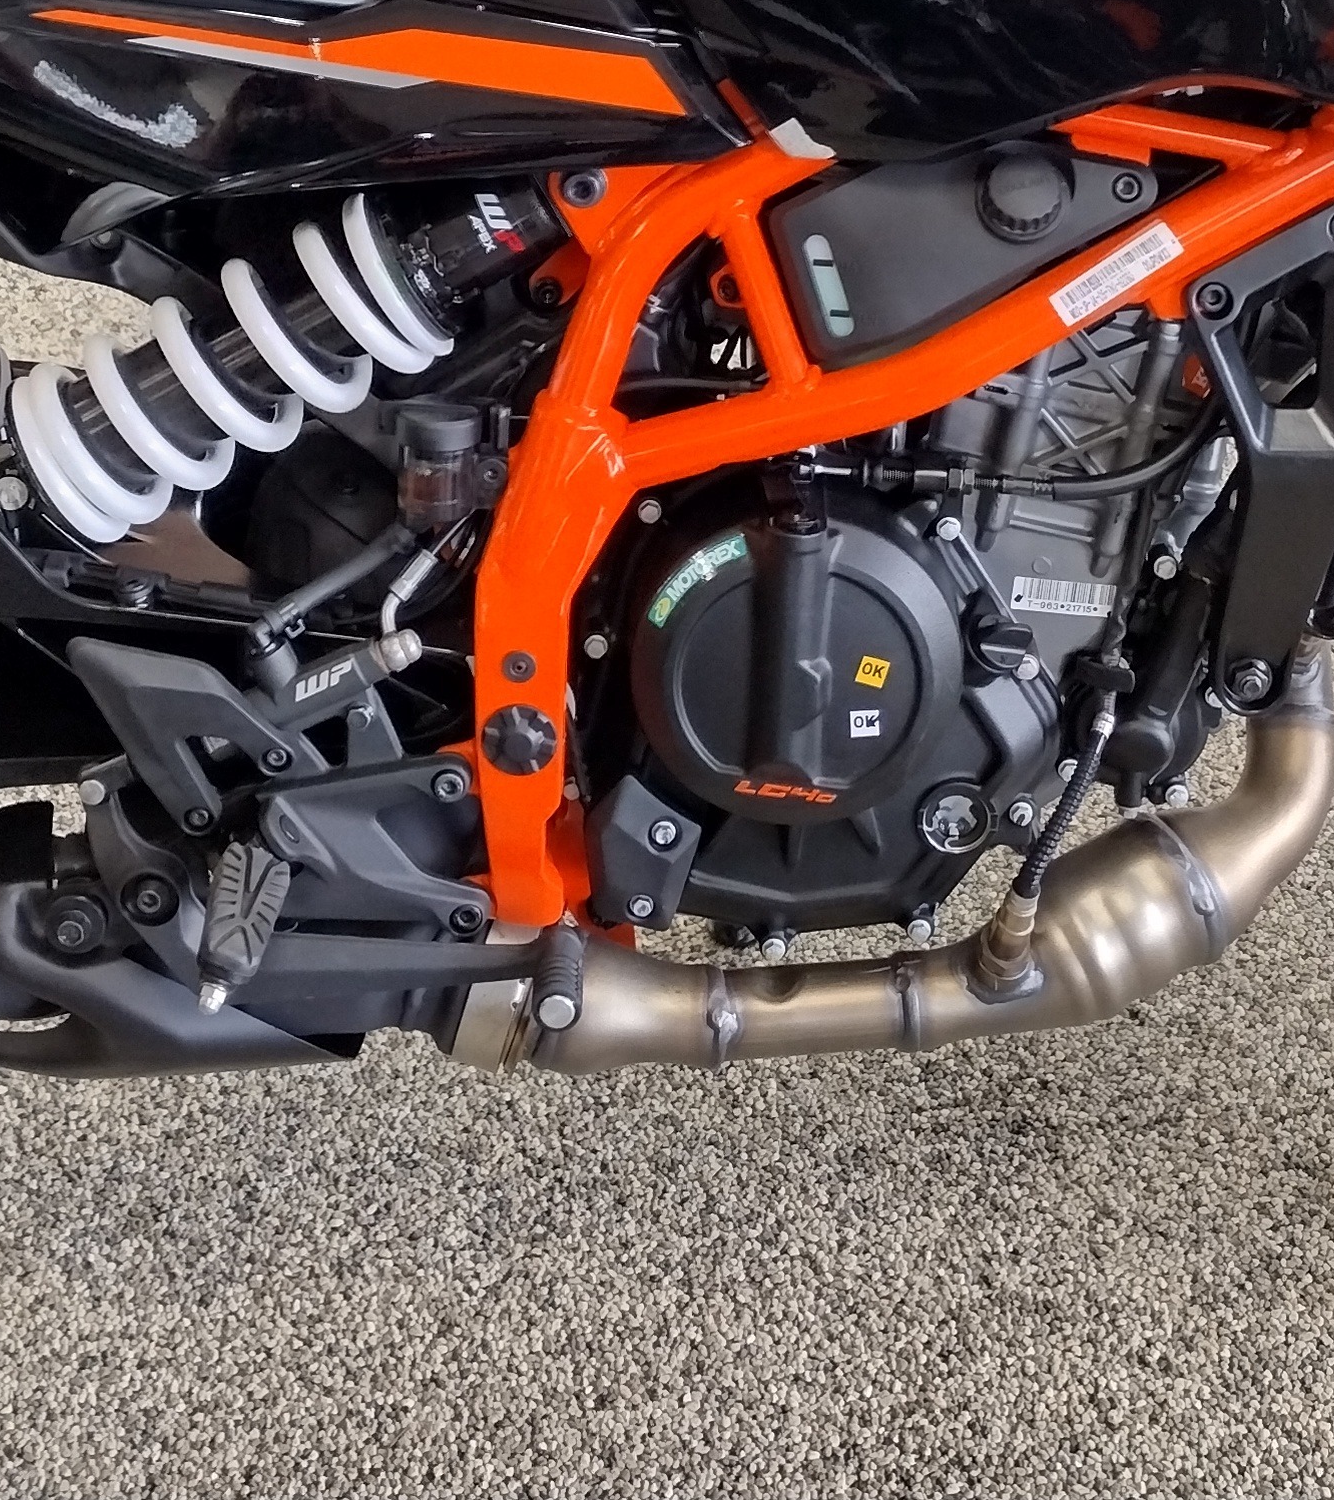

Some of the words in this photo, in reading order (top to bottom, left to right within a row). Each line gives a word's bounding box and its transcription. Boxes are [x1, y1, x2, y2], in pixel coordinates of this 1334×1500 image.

[467, 215, 497, 254] APEX
[474, 194, 526, 253] WP
[667, 539, 741, 601] MOTOREX
[294, 657, 357, 703] WP
[861, 661, 885, 679] OK
[853, 714, 878, 728] OK
